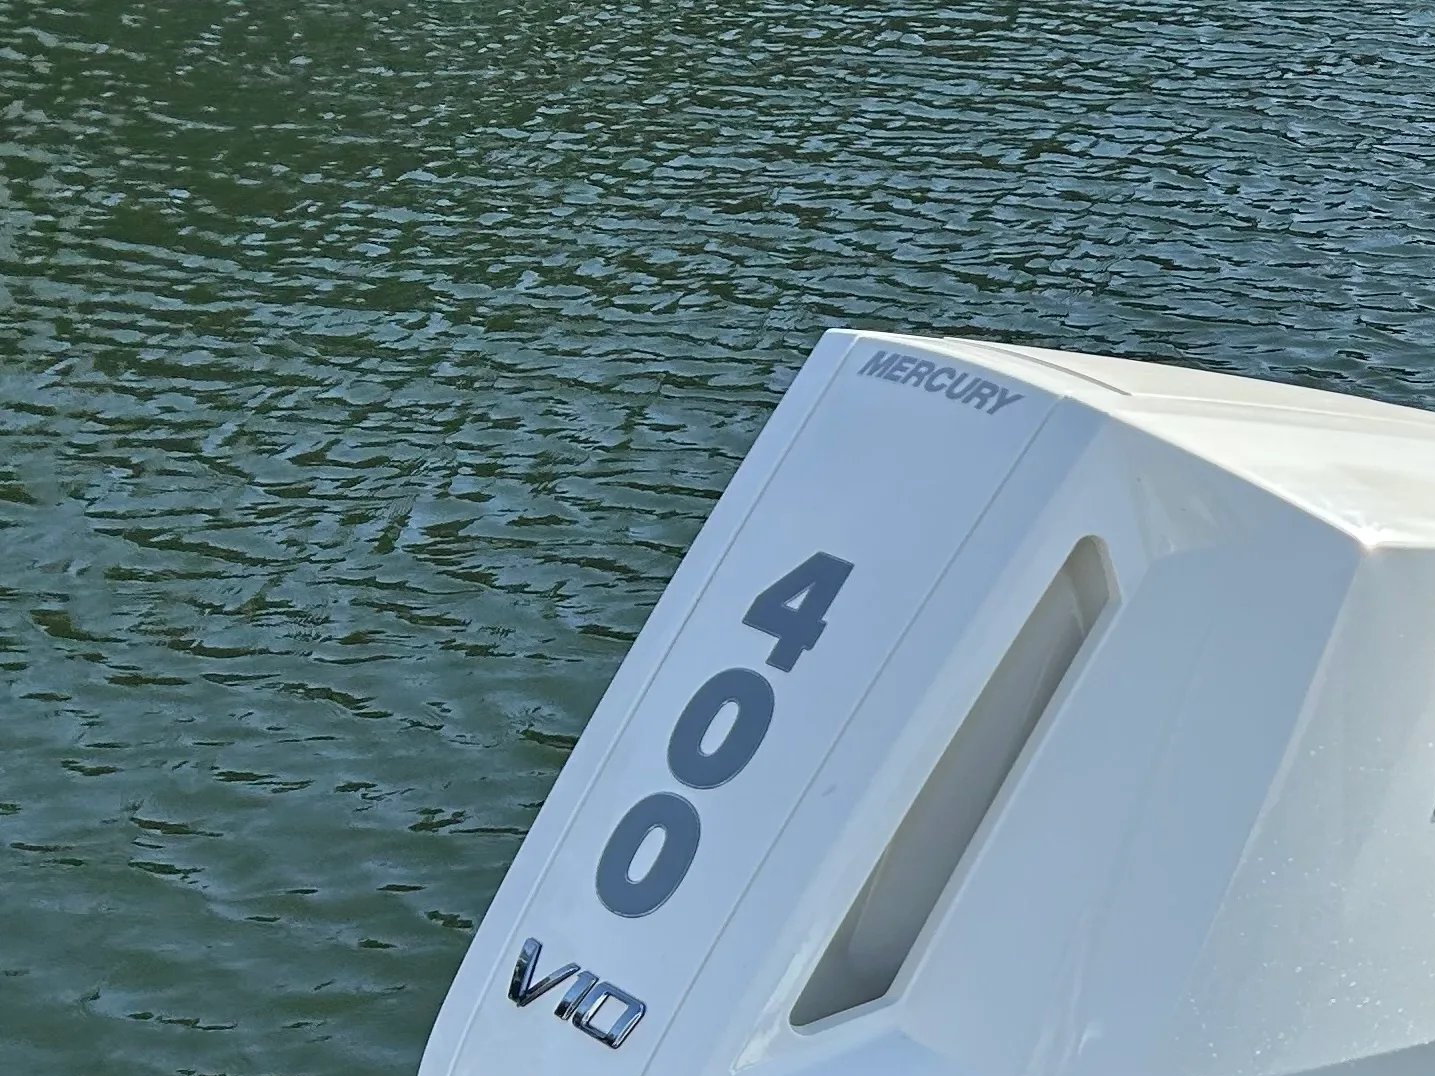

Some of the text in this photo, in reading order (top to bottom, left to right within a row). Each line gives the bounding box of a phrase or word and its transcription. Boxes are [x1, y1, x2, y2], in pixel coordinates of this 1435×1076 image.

[856, 350, 1025, 415] MERCURY
[595, 551, 855, 919] 400
[508, 937, 647, 1050] V10
